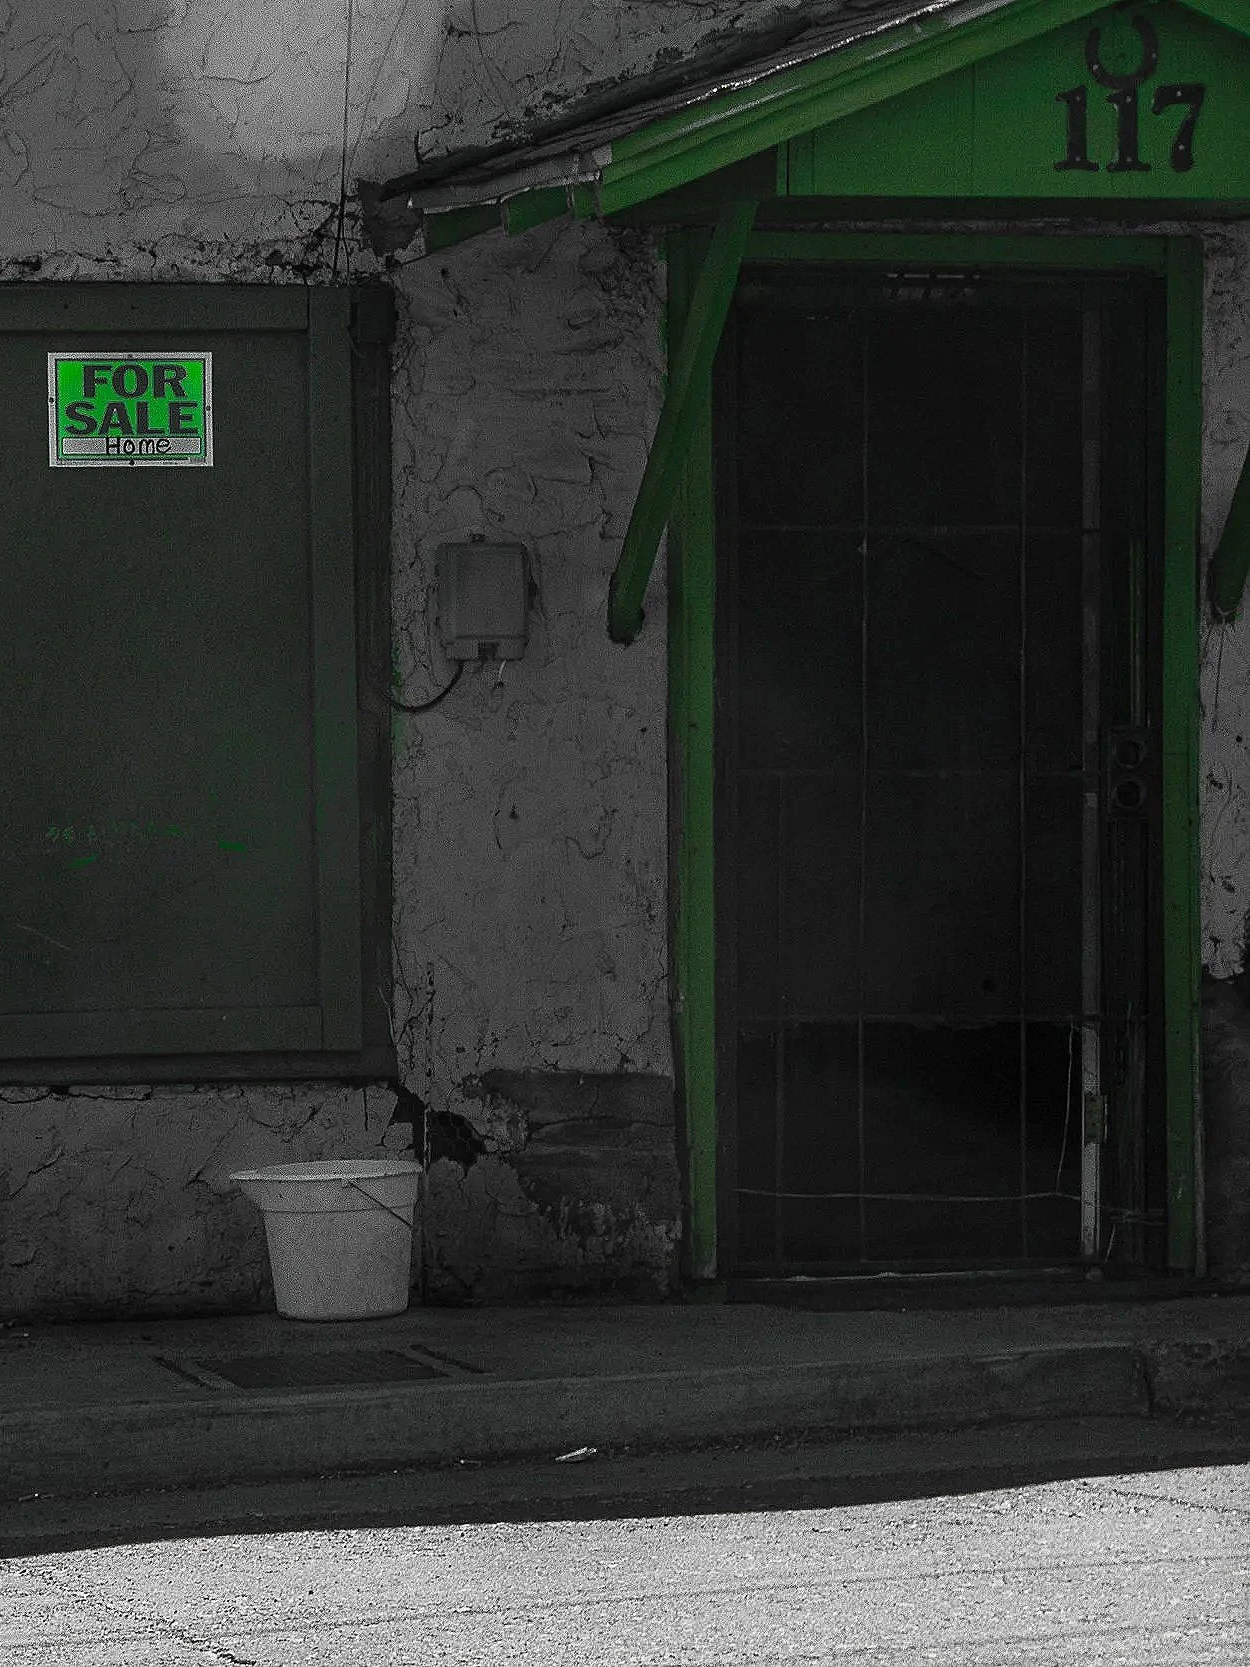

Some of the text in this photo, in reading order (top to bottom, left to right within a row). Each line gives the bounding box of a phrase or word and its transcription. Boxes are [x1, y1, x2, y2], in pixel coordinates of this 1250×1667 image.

[1054, 83, 1205, 172] 117
[83, 364, 188, 398] FOR
[65, 401, 199, 435] SALE
[105, 437, 172, 455] Home
